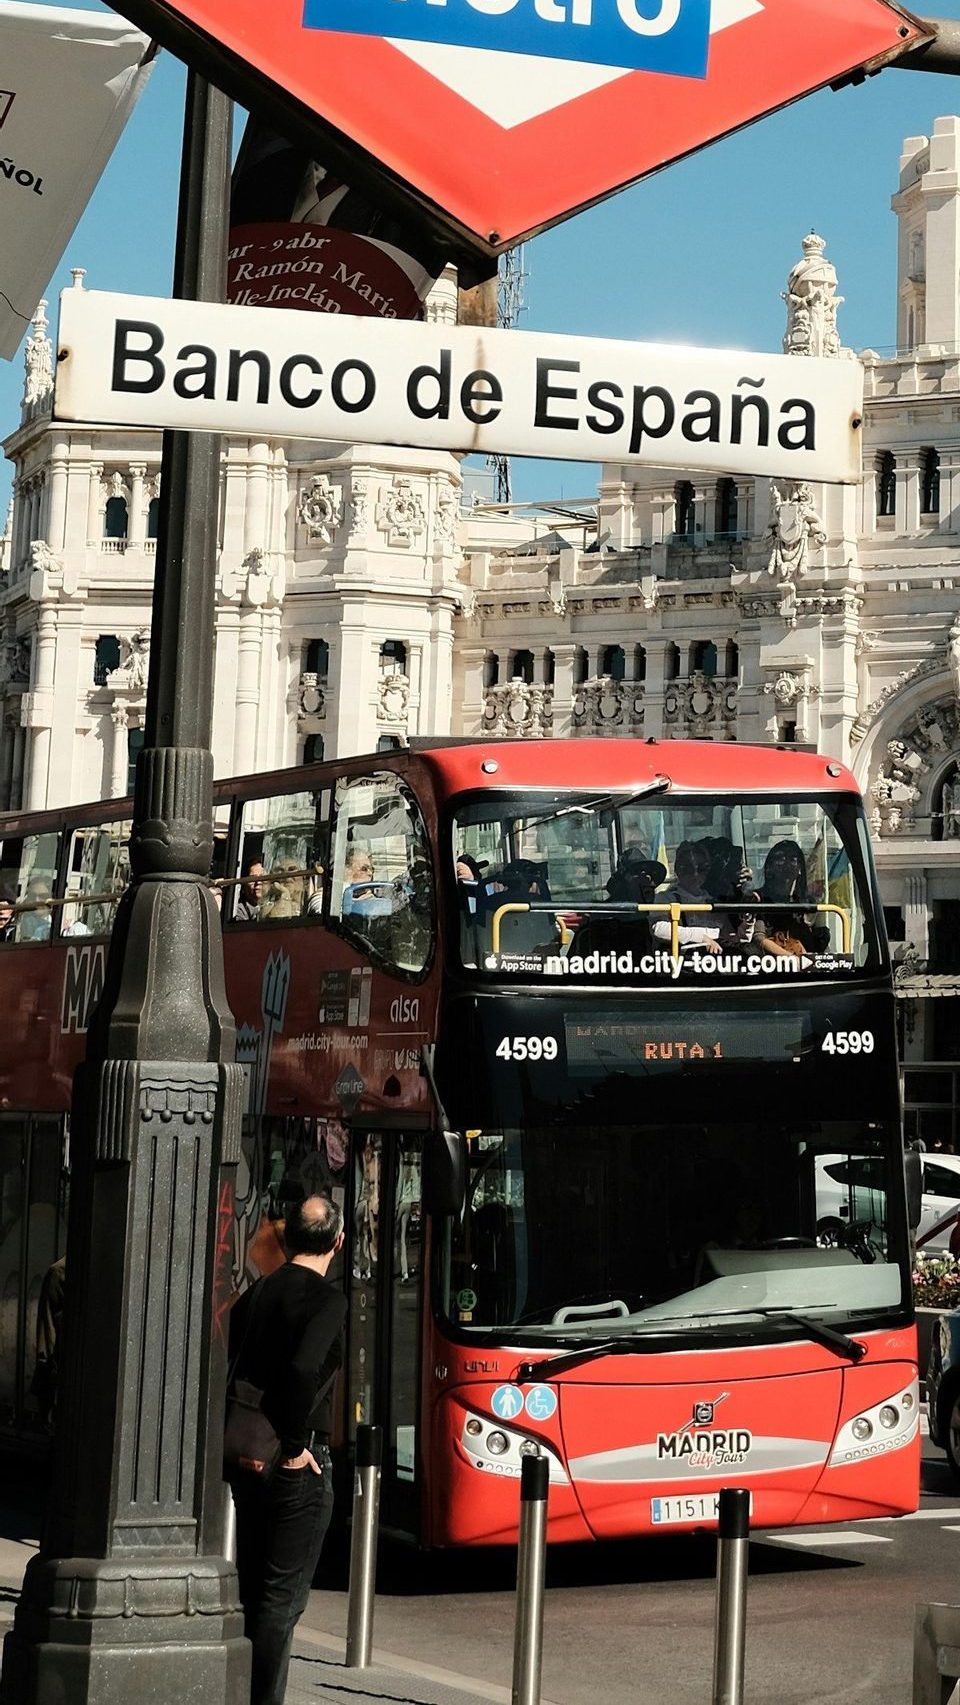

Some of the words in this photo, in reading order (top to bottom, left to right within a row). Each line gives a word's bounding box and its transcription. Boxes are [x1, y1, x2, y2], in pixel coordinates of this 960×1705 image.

[228, 243, 254, 260] ar
[286, 231, 331, 250] abr
[227, 283, 342, 314] lle-Inclán
[232, 255, 325, 283] Ramón
[330, 261, 398, 319] María
[111, 319, 376, 413] Banco
[406, 349, 503, 424] de
[534, 357, 816, 454] España
[500, 960, 519, 972] App
[519, 960, 542, 971] Store
[547, 950, 798, 979] madrid.city-tour.com
[815, 960, 839, 970] Google
[839, 960, 853, 970] Play
[390, 995, 419, 1023] alsa
[496, 1036, 558, 1061] 4599
[644, 1042, 704, 1060] RUTA
[713, 1042, 723, 1058] 1
[821, 1030, 875, 1054] 4599
[658, 1431, 751, 1458] MADRID
[689, 1451, 714, 1467] City
[716, 1449, 745, 1464] Tour
[664, 1498, 705, 1519] 1151
